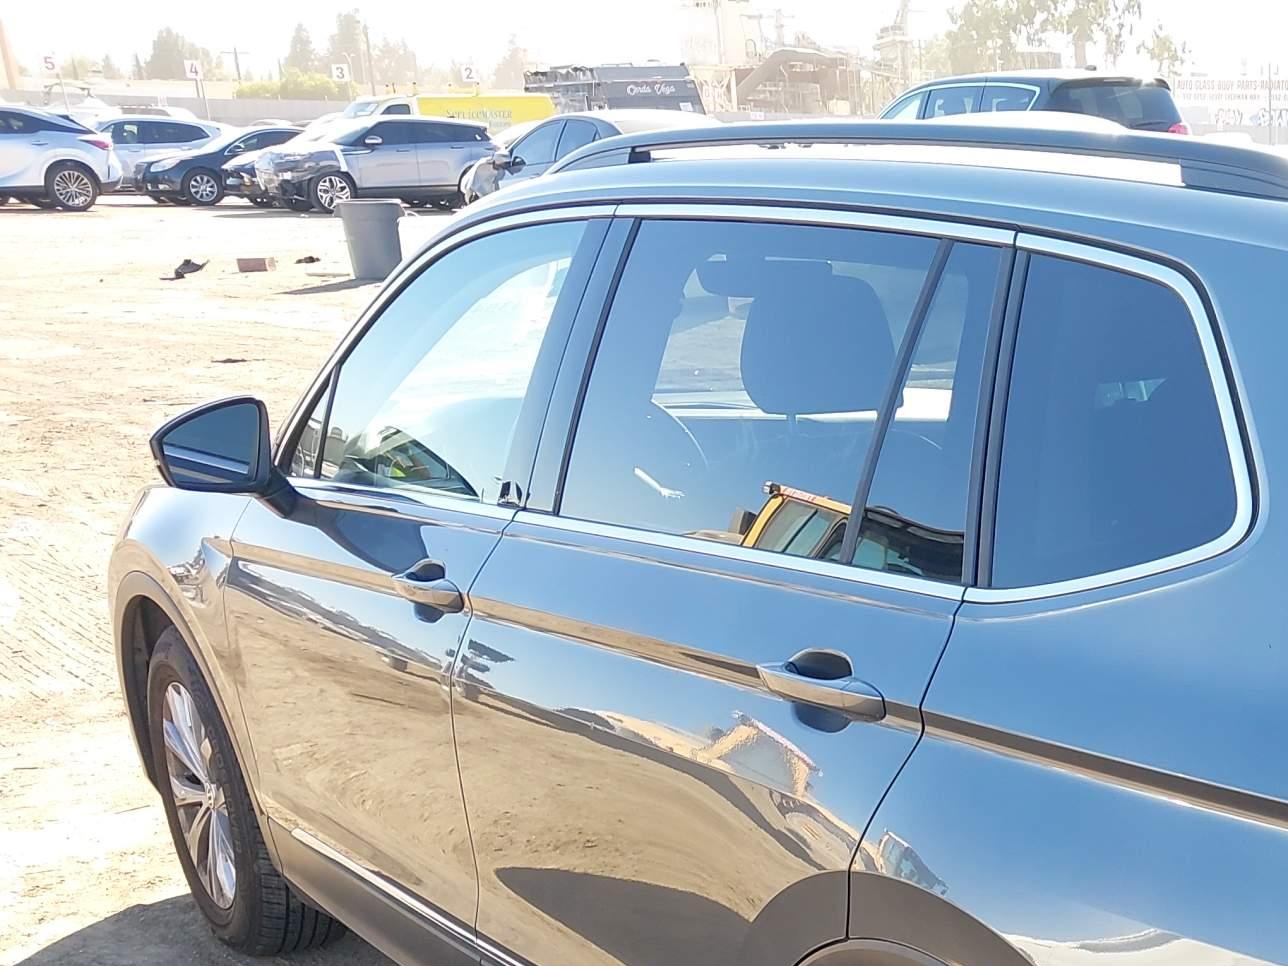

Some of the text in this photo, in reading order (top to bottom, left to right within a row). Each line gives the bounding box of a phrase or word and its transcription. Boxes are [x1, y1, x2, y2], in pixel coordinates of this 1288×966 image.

[44, 56, 55, 70] 5
[189, 63, 199, 76] 4
[335, 66, 345, 80] 3
[464, 67, 474, 80] 2
[1176, 79, 1193, 91] AUTO
[1195, 79, 1215, 91] GLASS
